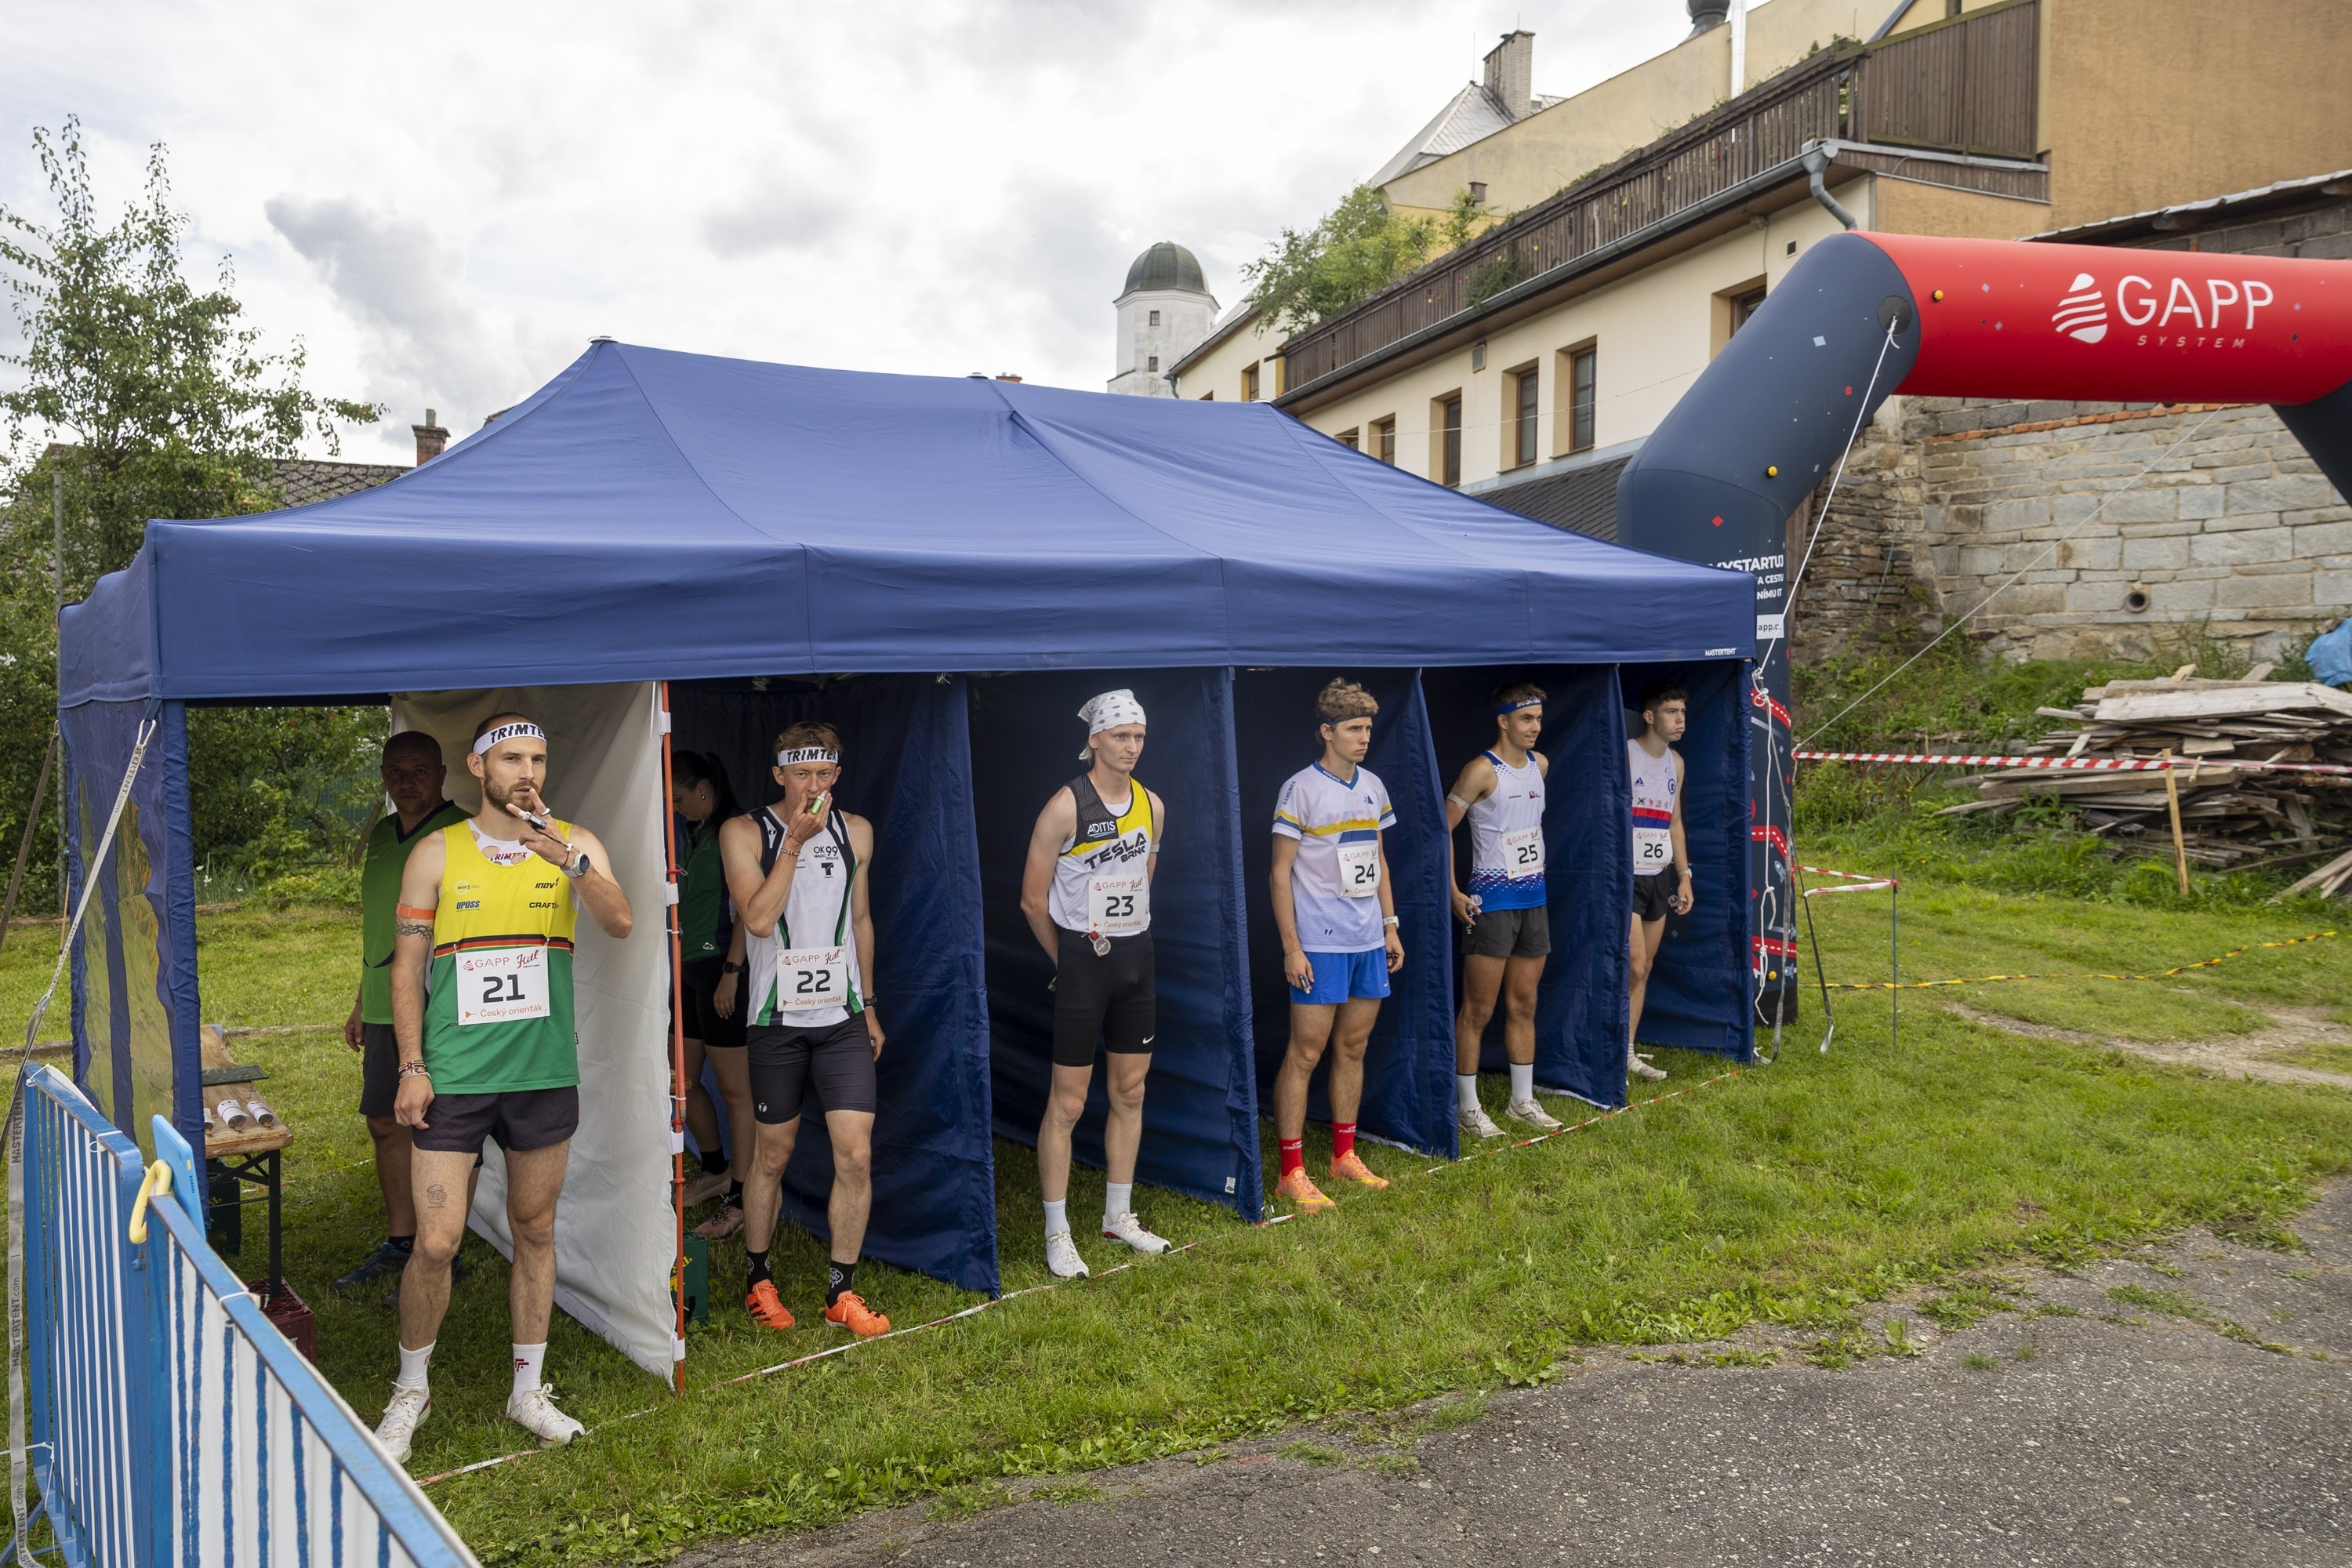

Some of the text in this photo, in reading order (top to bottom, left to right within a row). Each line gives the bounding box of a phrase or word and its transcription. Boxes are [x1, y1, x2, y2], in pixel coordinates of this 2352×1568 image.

[2116, 274, 2274, 331] GAPP
[2136, 334, 2245, 350] SYSTEM
[1708, 554, 1784, 572] YSTARTUJ
[1765, 573, 1784, 585] CESTU
[1704, 647, 1737, 657] MASTERTENT
[490, 723, 544, 744] TRIMTE
[1087, 820, 1116, 835] ADITIS
[1512, 833, 1529, 844] GAPP
[826, 845, 838, 856] 99
[1083, 832, 1147, 869] TESLA
[1349, 851, 1370, 860] GAPP
[1517, 844, 1539, 865] 25
[1643, 842, 1664, 858] 26
[1354, 862, 1376, 884] 24
[456, 900, 481, 909] UPOSS
[1105, 895, 1134, 917] 23
[474, 956, 510, 968] GAPP
[516, 949, 540, 970] Kitl
[792, 954, 820, 964] GAPP
[824, 949, 841, 965] Kitl
[482, 973, 526, 1004] 21
[797, 969, 831, 993] 22
[794, 995, 843, 1006] Český orienťák
[480, 1003, 543, 1018] Český orienťák
[11, 1276, 22, 1368] MASTERTENT.com
